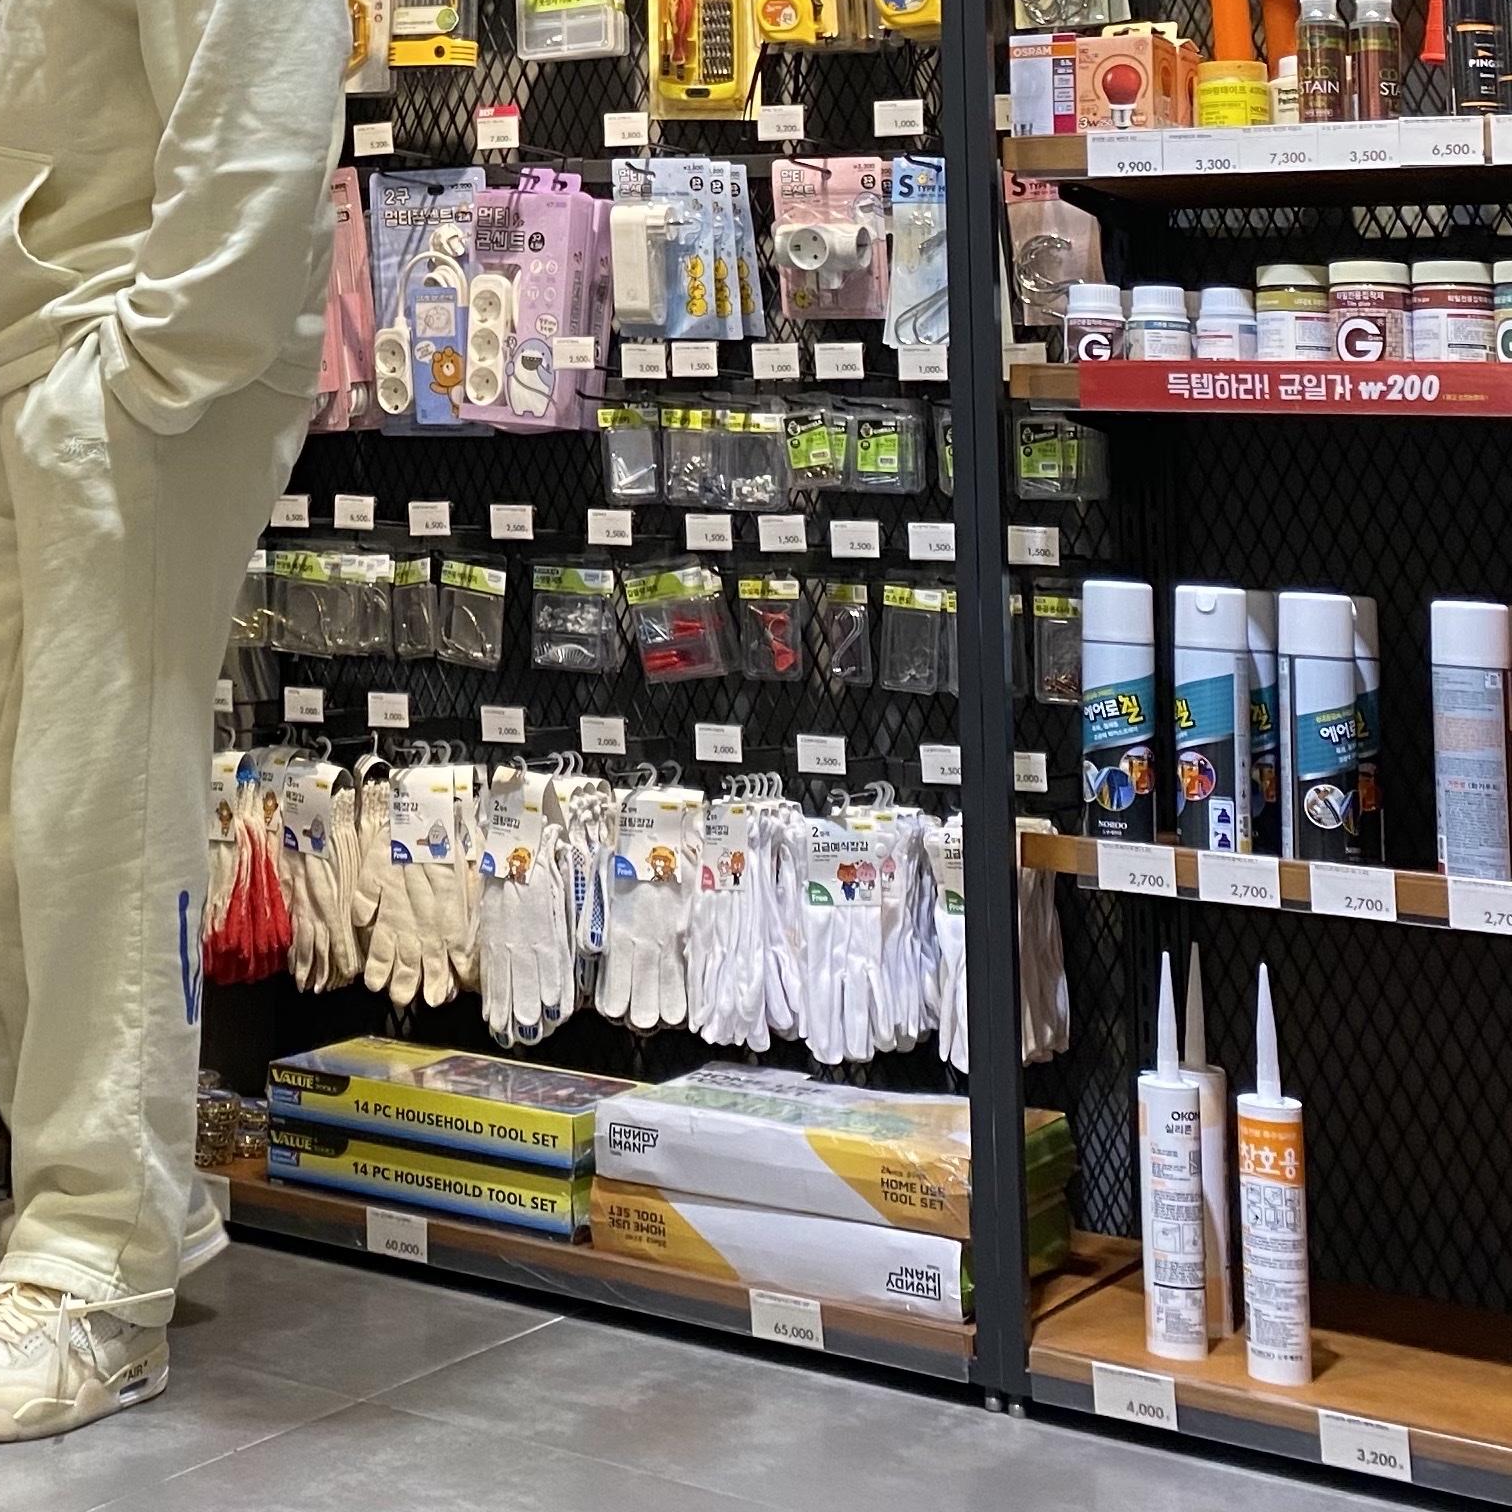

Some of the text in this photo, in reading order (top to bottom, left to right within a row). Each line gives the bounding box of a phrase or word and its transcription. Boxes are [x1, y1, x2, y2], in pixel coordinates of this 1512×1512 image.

[1013, 46, 1052, 57] OSRAM
[1299, 78, 1340, 95] STAIN
[1269, 151, 1307, 166] 7,300
[1349, 149, 1387, 164] 3,500
[1431, 143, 1470, 158] 6,500
[1117, 159, 1152, 174] 9,900
[1195, 157, 1232, 172] 3,300
[384, 189, 410, 205] 2구
[476, 206, 511, 228] 멀티
[475, 230, 525, 252] 콘센트
[919, 365, 940, 375] 1,000
[1167, 373, 1270, 402] 득템하라!
[1279, 373, 1352, 402] 균일가
[849, 542, 874, 551] 2,500
[1098, 819, 1128, 830] NOROO
[811, 839, 869, 854] 고급예식장갑
[1129, 871, 1164, 888] 2,700
[1231, 883, 1268, 900] 2,700
[1344, 895, 1383, 912] 2,700
[271, 1068, 315, 1089] VALUE
[353, 1099, 559, 1149] 14 PC HOUSEHOLD TOOL SET
[270, 1130, 313, 1151] VALUE
[1240, 1140, 1300, 1179] 창호용
[352, 1161, 557, 1214] 14 PC HOUSEHOLD TOOL SET
[880, 1178, 917, 1194] HOME
[882, 1190, 944, 1211] TOOL SET
[384, 1238, 419, 1256] 60,000
[774, 1322, 814, 1341] 65,000
[1126, 1400, 1164, 1420] 4,000
[1357, 1448, 1397, 1469] 3,200
